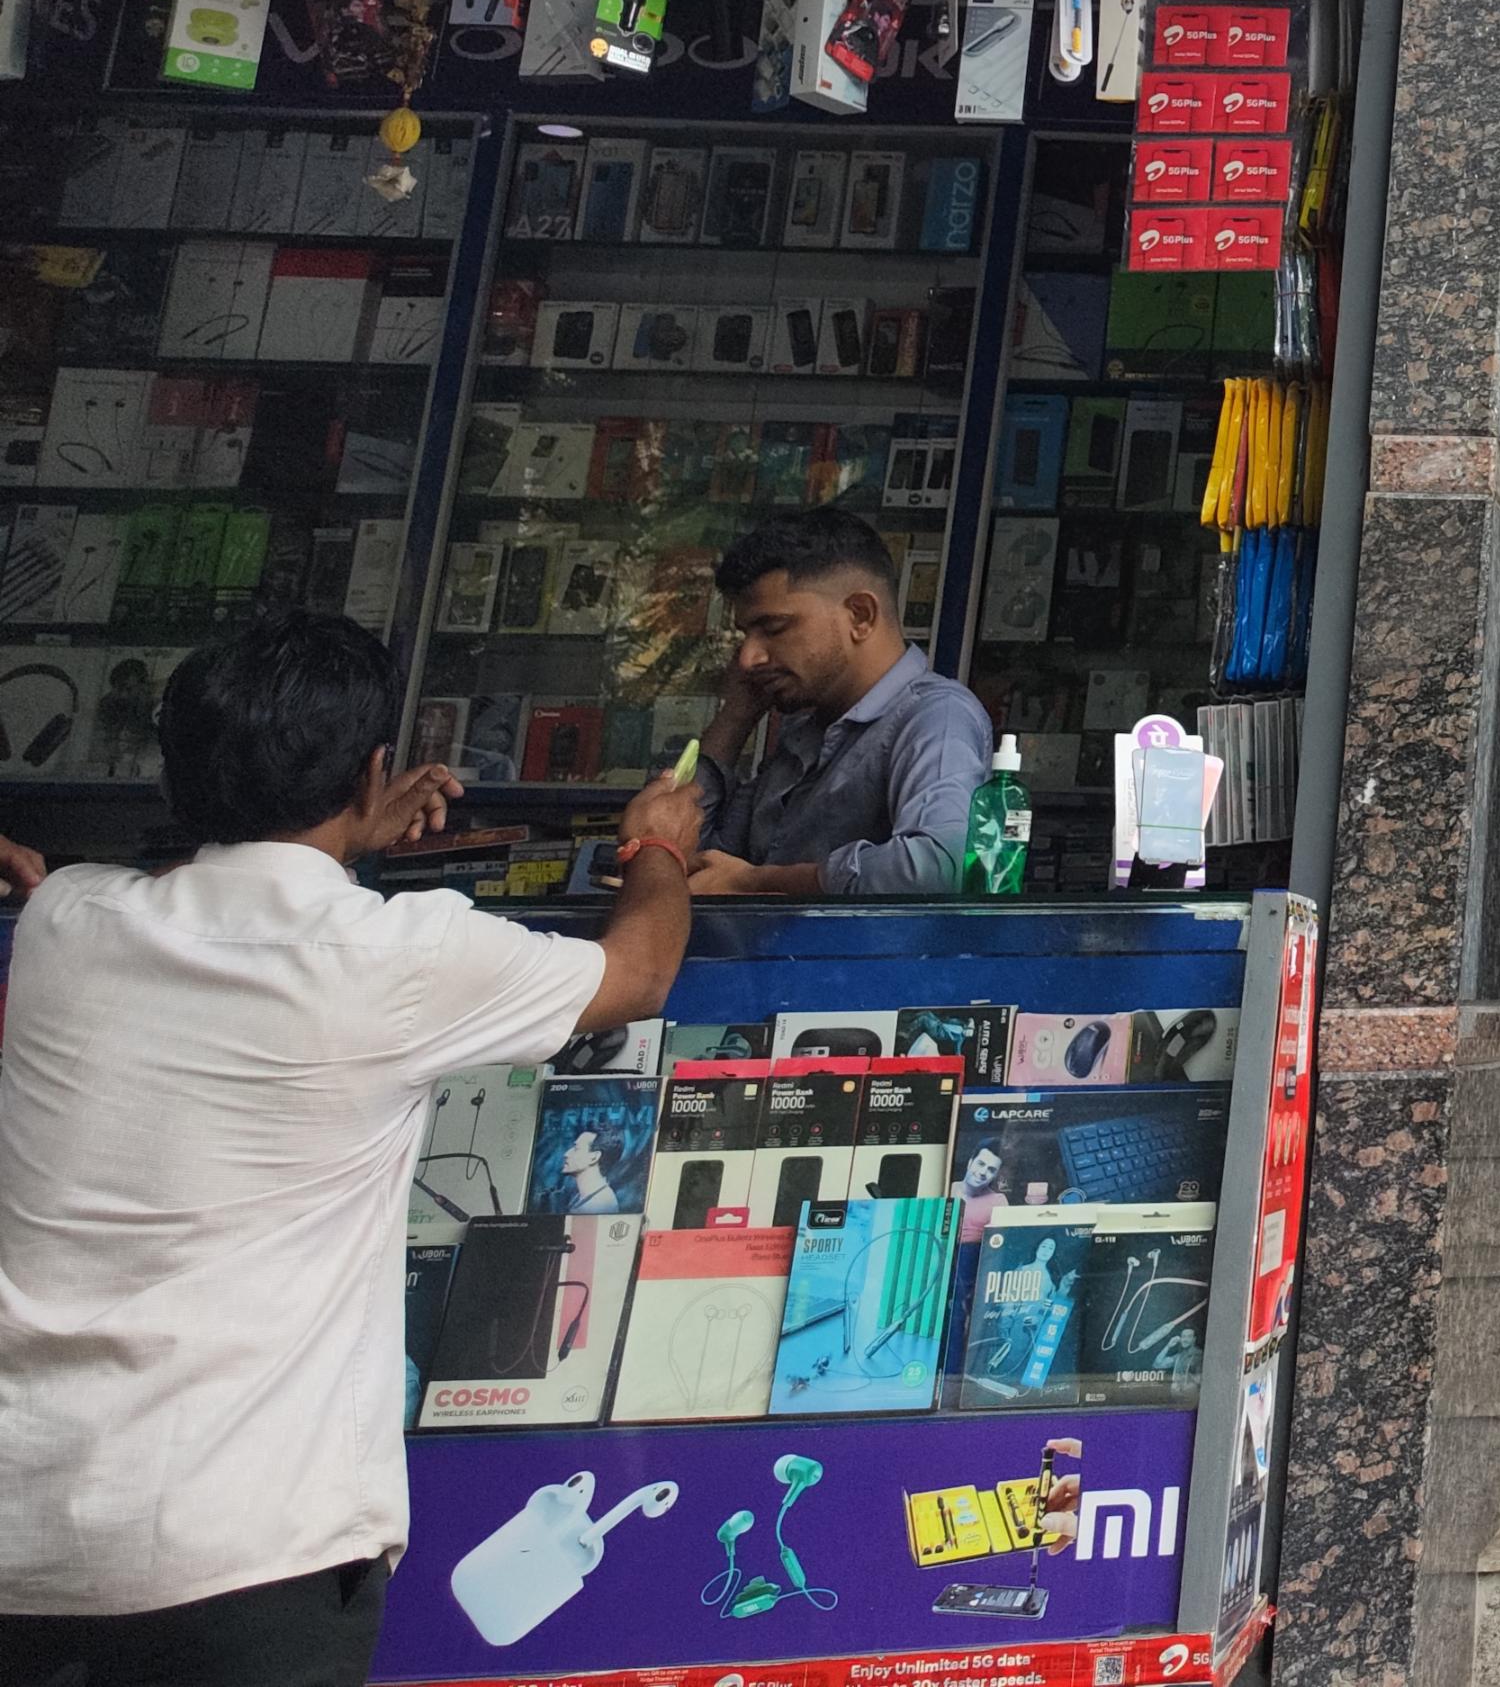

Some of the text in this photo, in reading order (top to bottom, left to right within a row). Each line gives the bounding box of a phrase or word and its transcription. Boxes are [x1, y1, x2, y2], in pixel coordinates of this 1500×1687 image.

[671, 1099, 707, 1113] 10000
[770, 1096, 806, 1110] 10000
[869, 1094, 904, 1108] 10000
[991, 1108, 1051, 1119] LAPCARE
[803, 1238, 843, 1253] SPORTY
[434, 1387, 530, 1408] COSMO
[1193, 1653, 1210, 1665] 5G
[850, 1664, 892, 1680] Enjoy
[895, 1656, 969, 1675] Unlimited
[972, 1654, 994, 1669] 5G
